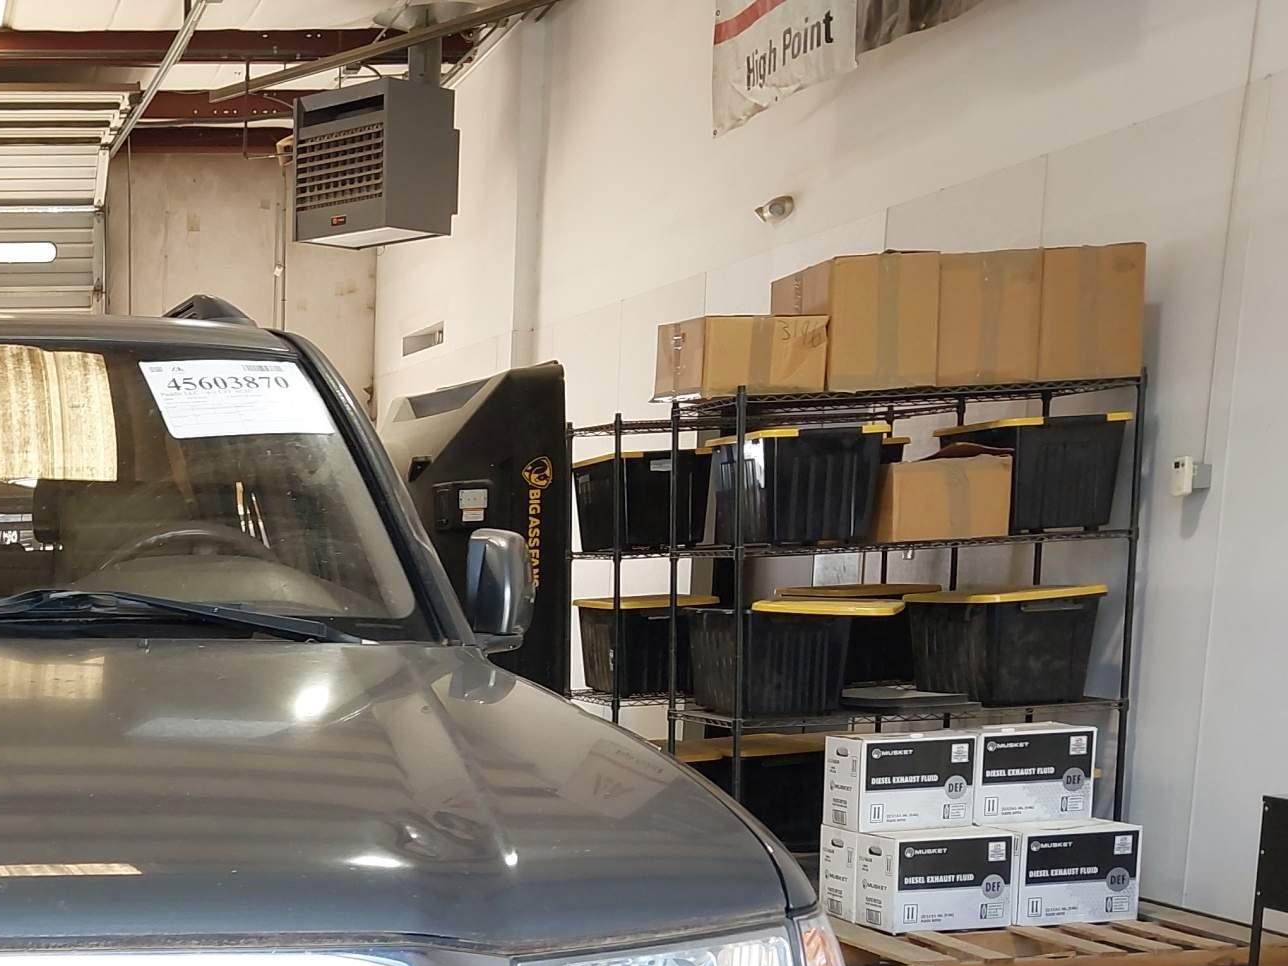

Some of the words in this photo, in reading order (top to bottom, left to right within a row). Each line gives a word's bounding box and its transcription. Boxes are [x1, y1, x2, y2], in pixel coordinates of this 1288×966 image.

[746, 40, 777, 91] High
[782, 9, 834, 67] Point
[167, 375, 290, 391] 45603870
[528, 489, 541, 515] BIG
[528, 516, 541, 548] ASS
[985, 769, 1007, 777] DIESEL
[1007, 767, 1036, 776] EXHAUST
[1036, 766, 1055, 775] FLUID
[871, 777, 892, 785] DIESEL
[892, 775, 921, 784] EXHAUST
[921, 774, 939, 782] FLUID
[1066, 774, 1081, 785] DEF
[948, 782, 964, 792] DEF
[1028, 869, 1050, 878] DIESEL
[1050, 867, 1079, 876] EXHAUST
[1079, 866, 1099, 875] FLUID
[904, 876, 925, 885] DIESEL
[926, 874, 955, 884] EXHAUST
[956, 873, 975, 882] FLUID
[1109, 874, 1126, 885] DEF
[985, 881, 1001, 892] DEF
